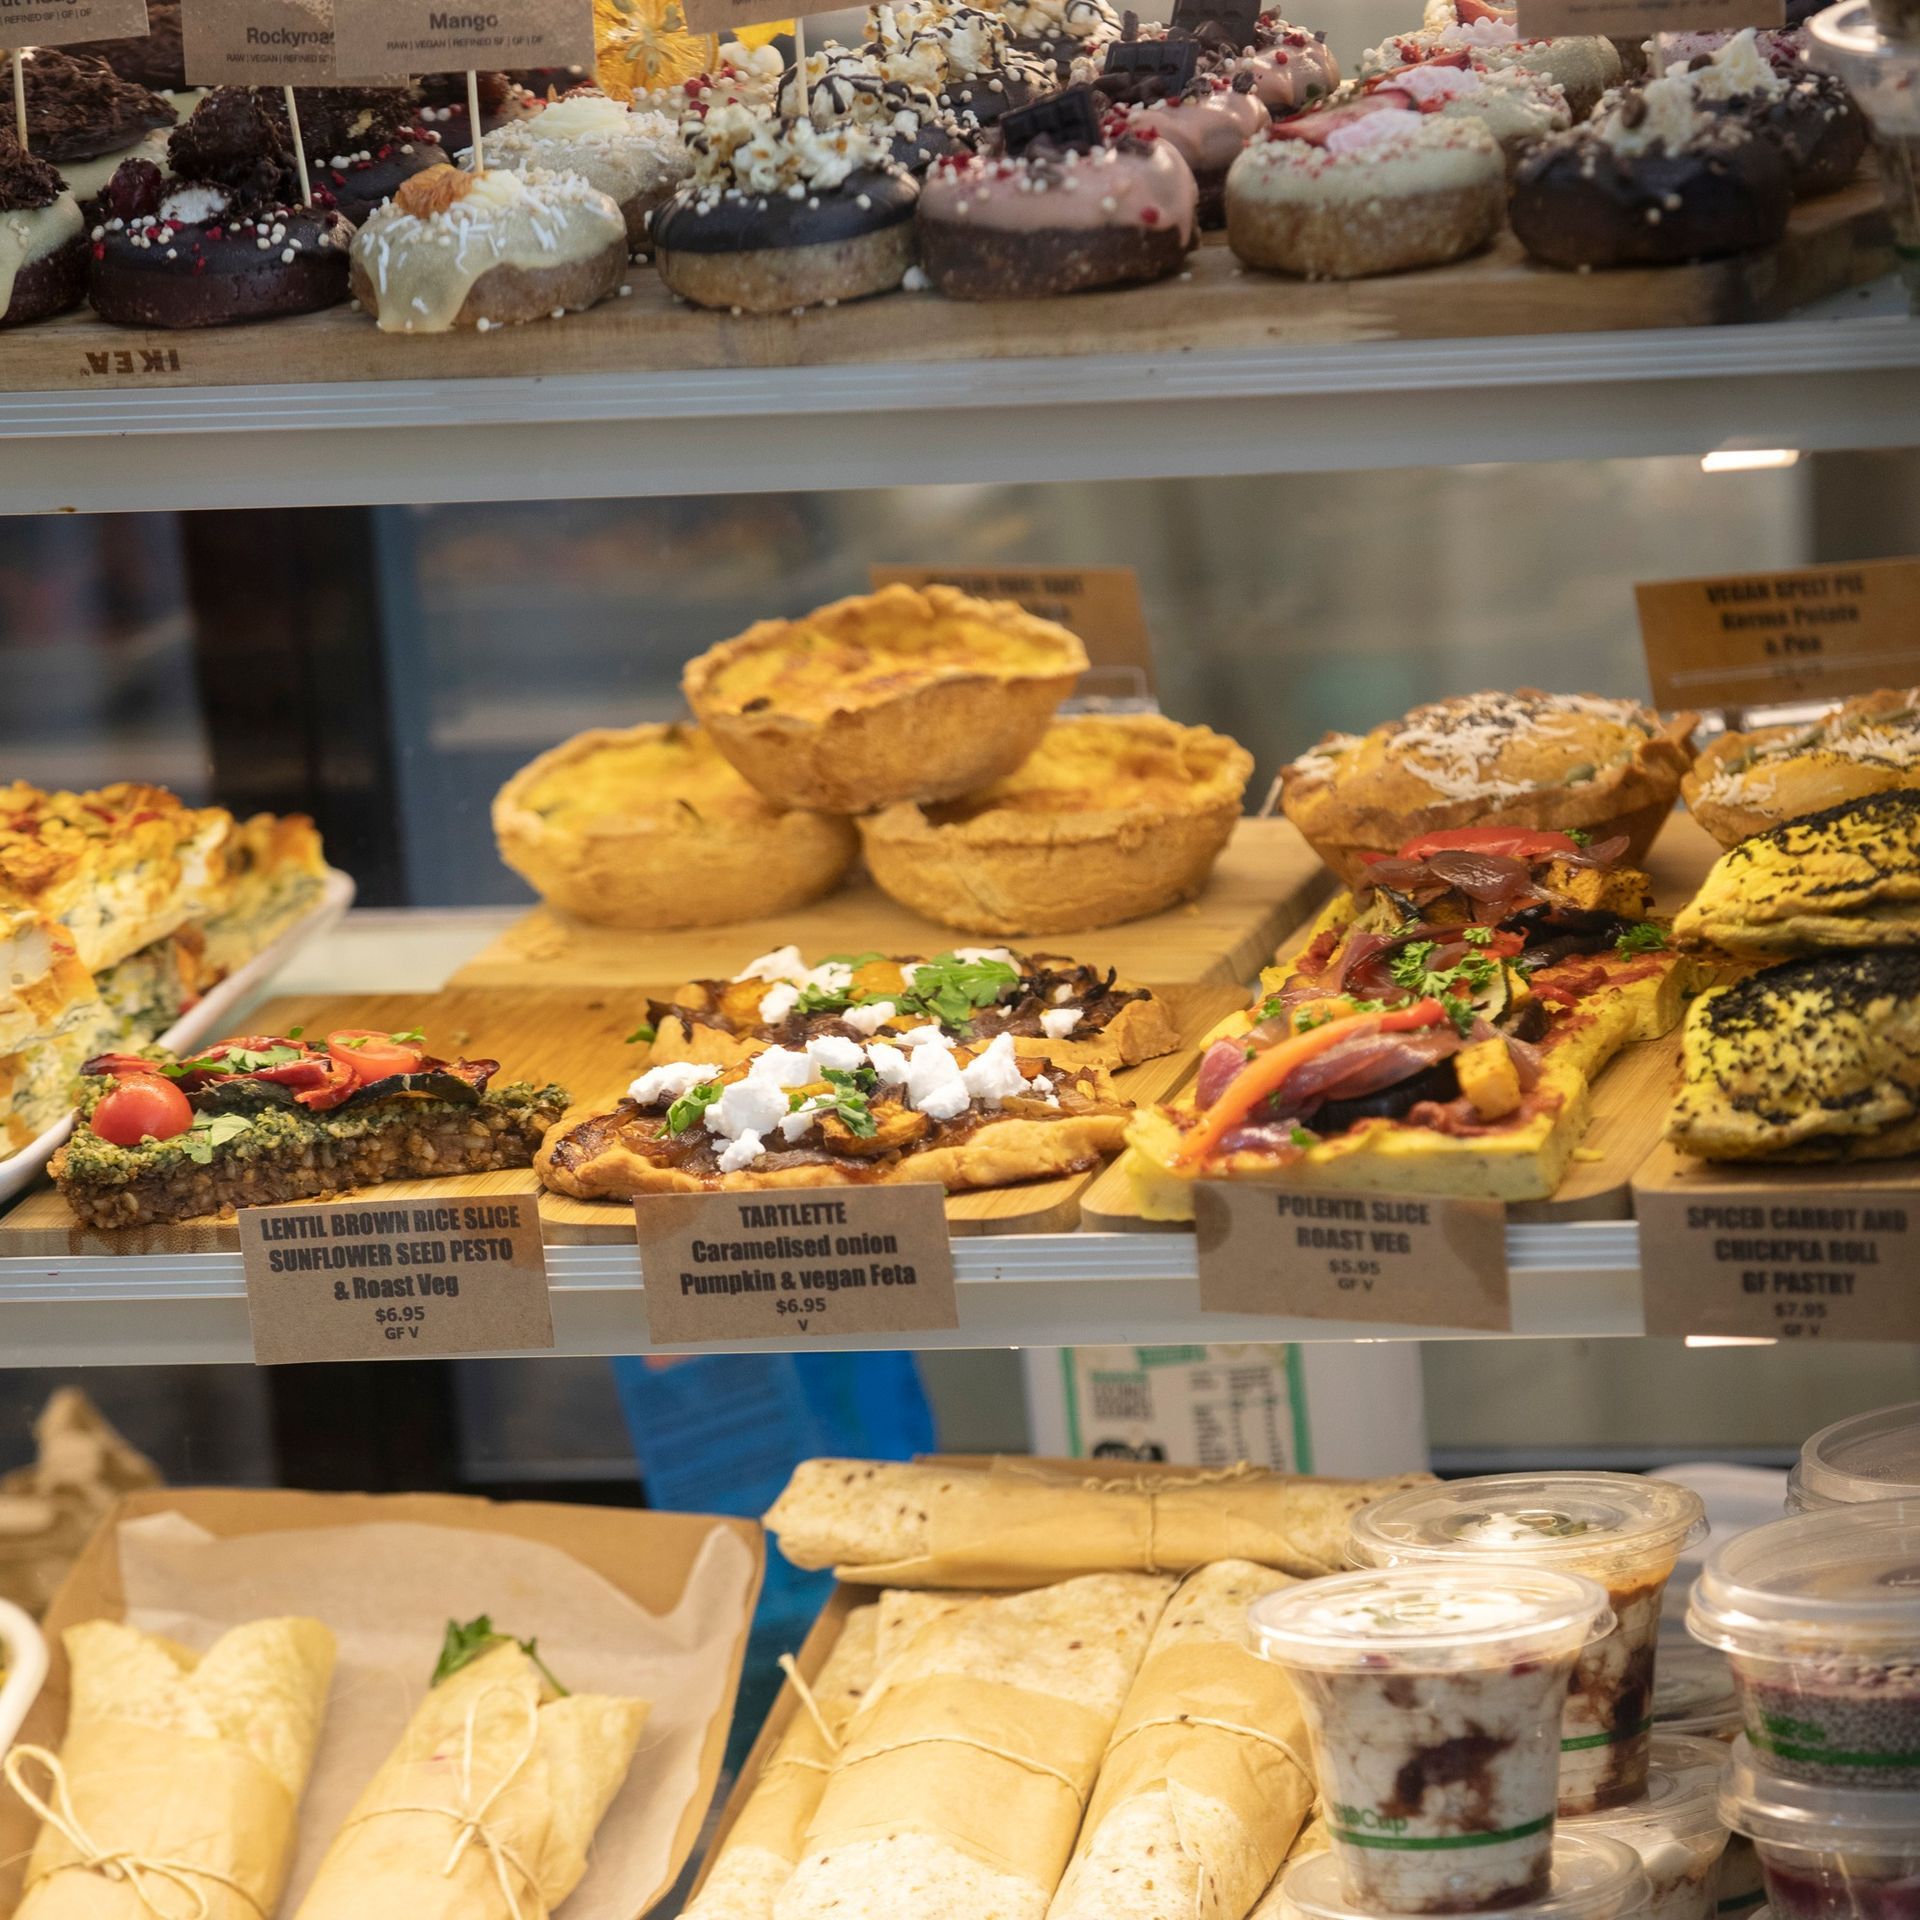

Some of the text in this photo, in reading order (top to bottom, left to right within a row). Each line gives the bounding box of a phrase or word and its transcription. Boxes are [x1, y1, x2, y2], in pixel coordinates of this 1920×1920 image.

[4, 13, 41, 24] REFINED
[61, 10, 73, 19] GF
[80, 8, 91, 17] DF
[429, 12, 499, 31] Mango
[387, 41, 408, 50] RAW
[415, 39, 446, 49] VEGAN
[452, 38, 491, 47] REFINED
[226, 54, 245, 62] RAW
[252, 54, 278, 62] VEGAN
[283, 54, 316, 63] REFINED
[85, 349, 181, 375] IKEA
[739, 1202, 848, 1229] TARTLETTE
[1277, 1194, 1431, 1226] POLENTA SLICE
[1686, 1206, 1909, 1232] SPICED CARROT AND
[260, 1205, 521, 1242] LENTIL BROWN RICE SLICE
[691, 1233, 899, 1263] Caramelised onion
[1296, 1226, 1412, 1255] ROAST VEG
[1714, 1238, 1880, 1264] CHICKPEA ROLL
[269, 1238, 513, 1273] SUNFLOWER SEED PESTO
[1328, 1258, 1382, 1277] $5.95
[333, 1273, 460, 1301] & Roast Veg
[680, 1263, 917, 1296] Pumpkin & vegan Feta
[1337, 1277, 1358, 1291] GF
[1773, 1271, 1856, 1295] PASTRY
[374, 1306, 425, 1325] $6.95
[775, 1297, 827, 1317] $6.95
[384, 1326, 420, 1340] GF V
[797, 1319, 809, 1332] V
